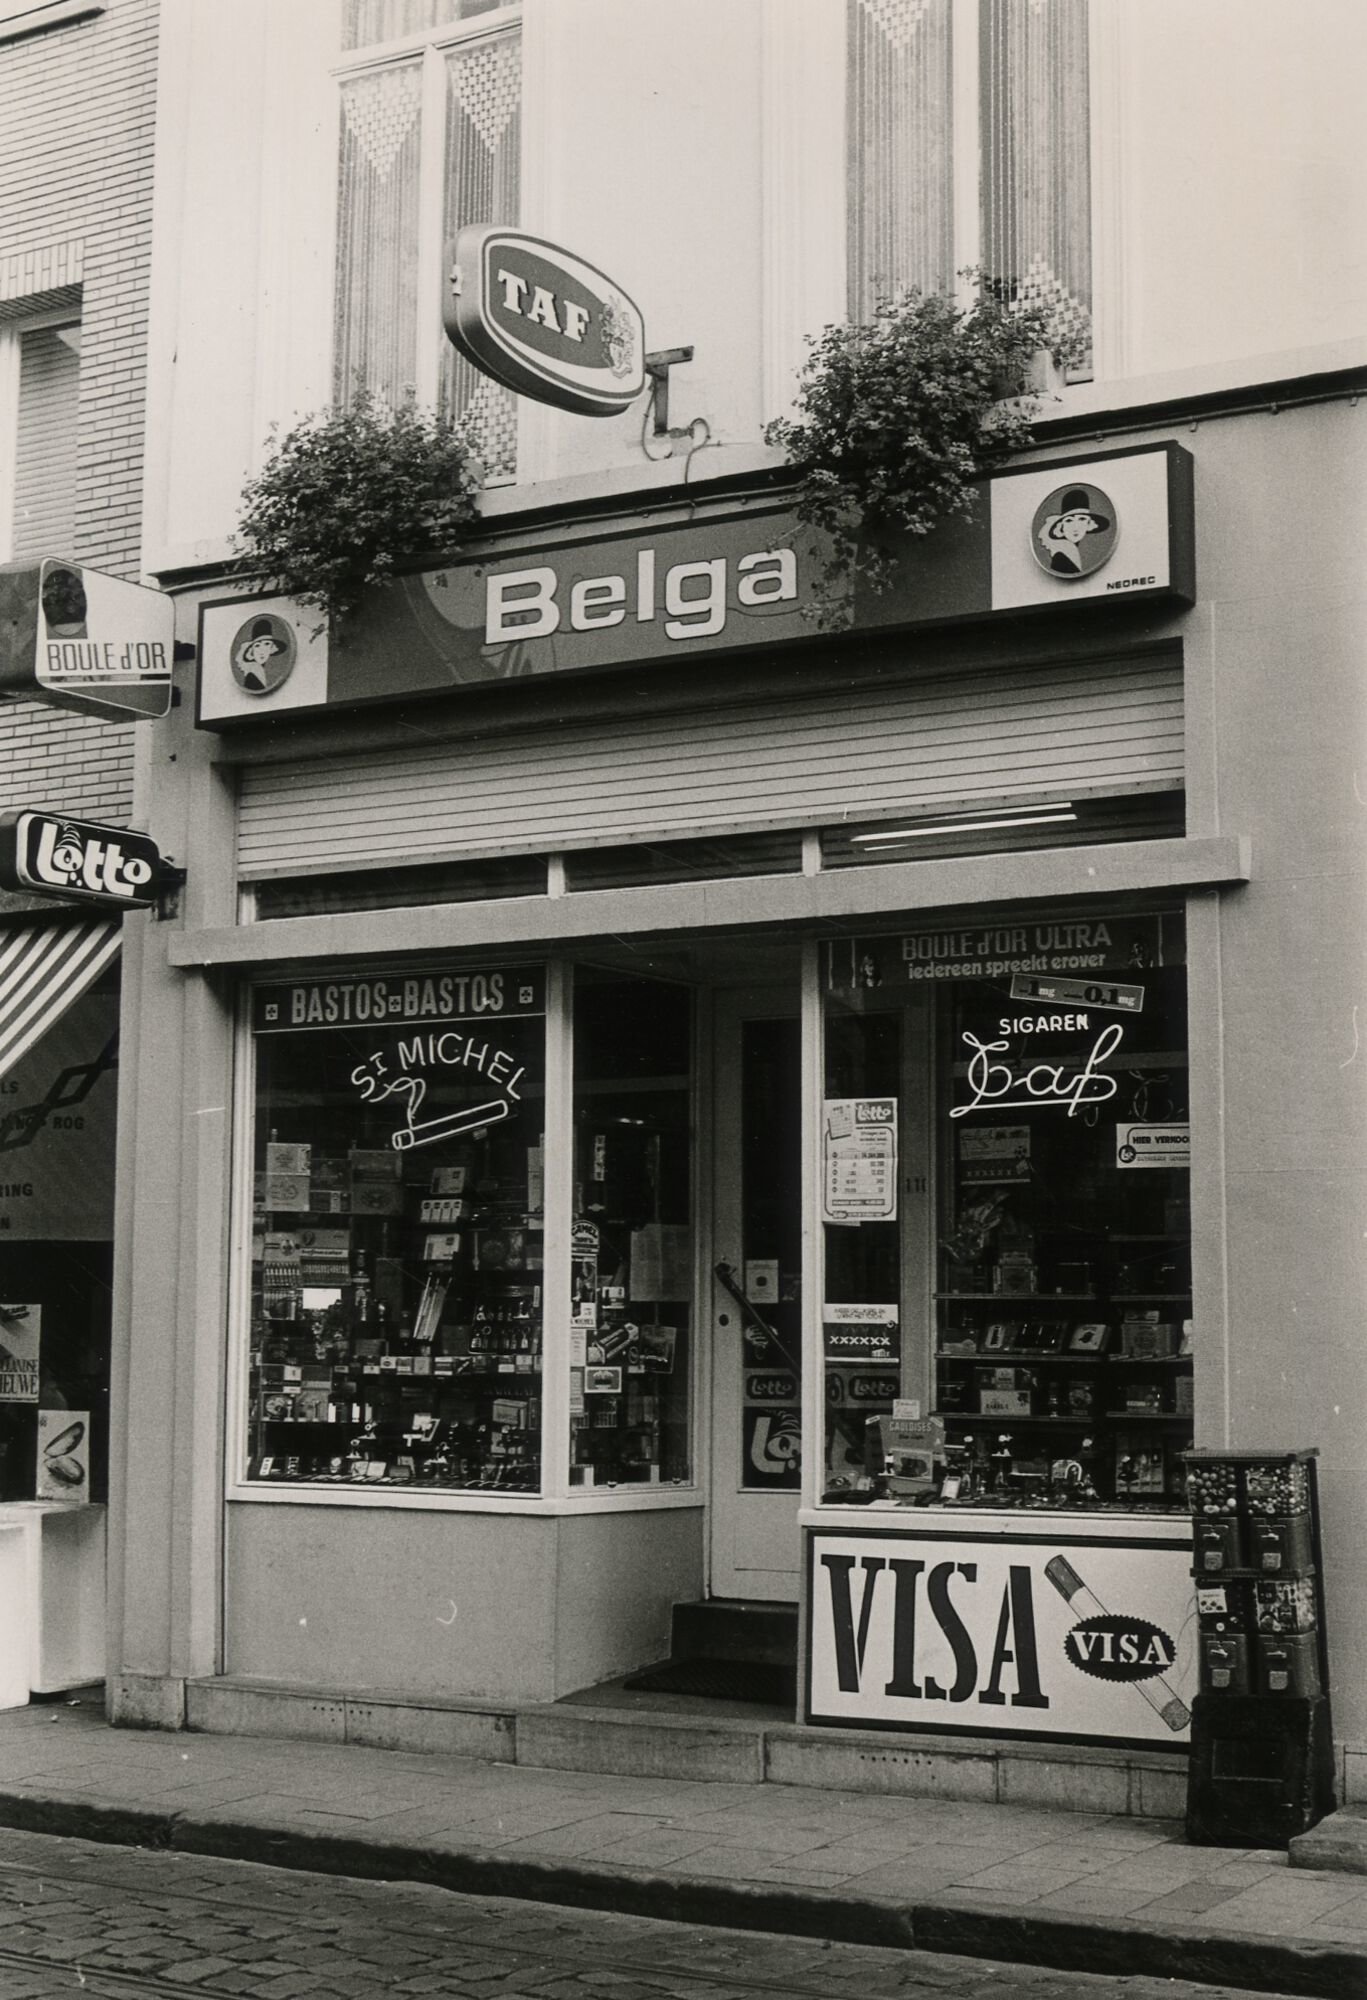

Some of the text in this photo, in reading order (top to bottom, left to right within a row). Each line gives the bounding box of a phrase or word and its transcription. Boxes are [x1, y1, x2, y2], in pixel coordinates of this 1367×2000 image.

[497, 268, 590, 343] TAF
[485, 548, 798, 645] Belga
[46, 642, 166, 672] BOULE d'OR
[902, 923, 1113, 961] BOULE d'OR ULTRA
[908, 952, 1106, 979] iedereen spreekt erover
[291, 974, 504, 1024] BASTOS BASTOS
[999, 1014, 1089, 1035] SIGAREN
[397, 1033, 526, 1101] MICHEL
[53, 1117, 84, 1129] ROG
[752, 1377, 793, 1396] Lotto
[854, 1379, 896, 1396] Lotto
[889, 1421, 932, 1432] GAULOISES
[821, 1554, 1049, 1708] VISA
[1069, 1631, 1171, 1665] VISA
